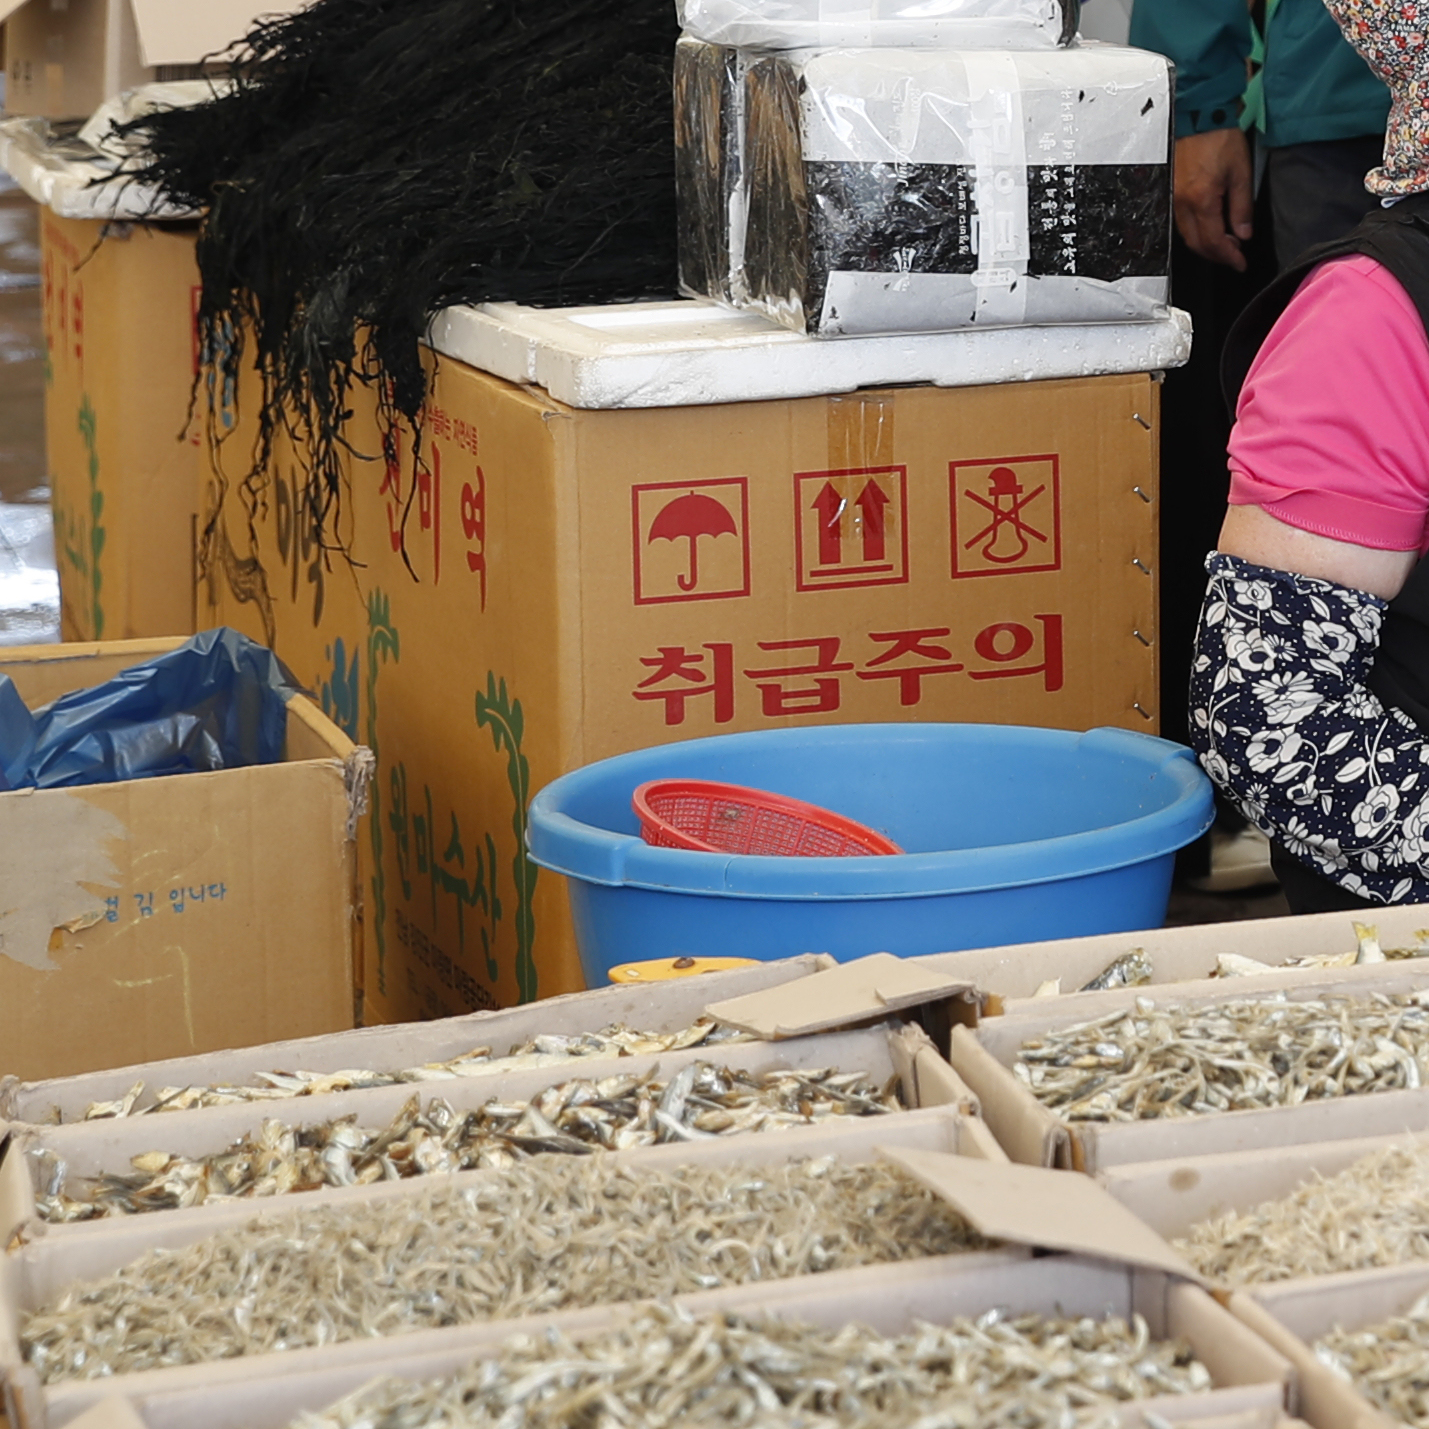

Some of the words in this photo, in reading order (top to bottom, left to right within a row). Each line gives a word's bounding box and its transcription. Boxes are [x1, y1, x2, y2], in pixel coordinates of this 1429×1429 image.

[1059, 232, 1077, 274] 고유의
[631, 613, 1066, 726] 취급주의
[169, 883, 227, 913] 입니다
